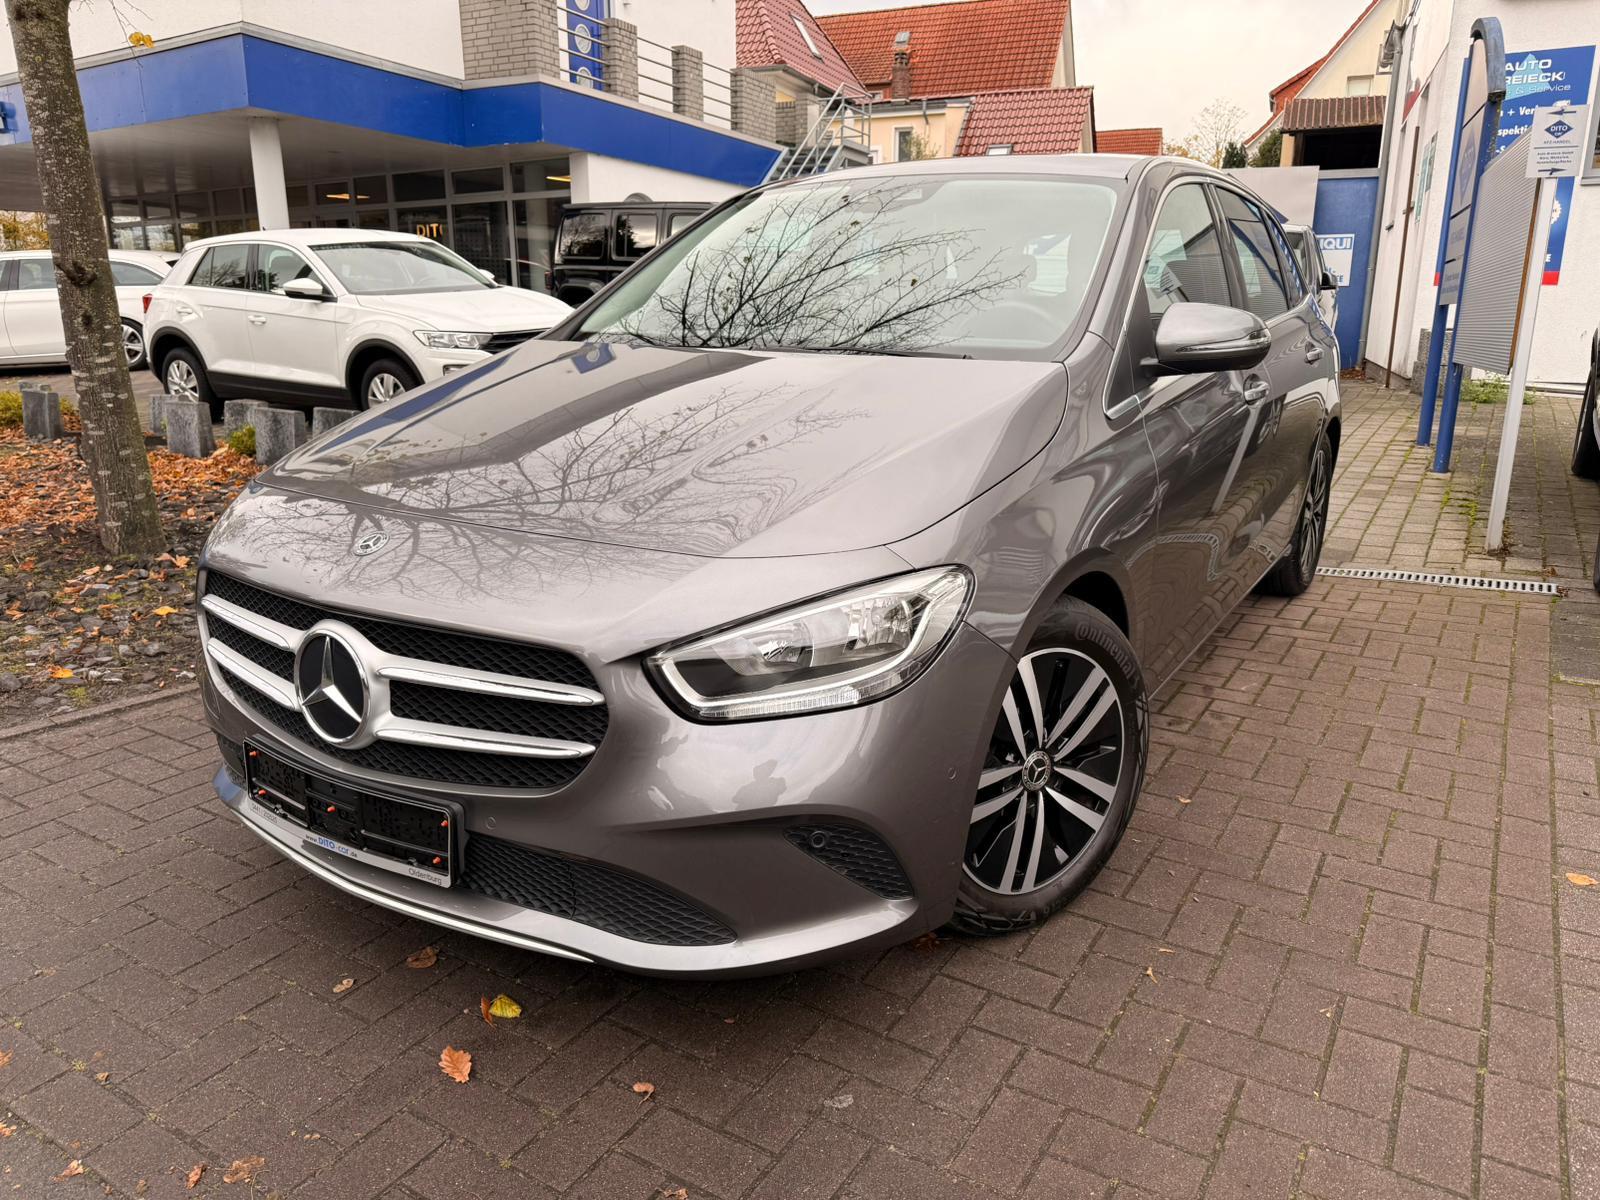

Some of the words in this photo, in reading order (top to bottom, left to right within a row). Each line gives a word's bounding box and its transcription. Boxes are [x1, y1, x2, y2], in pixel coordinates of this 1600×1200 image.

[1504, 59, 1552, 71] AUTO
[1505, 71, 1565, 84] REIECK
[1528, 84, 1571, 93] Service
[1519, 105, 1537, 116] Ver
[1497, 124, 1528, 137] spekti
[1319, 237, 1352, 249] IQUI
[1075, 621, 1136, 680] Continental
[408, 867, 442, 886] Oldenburg
